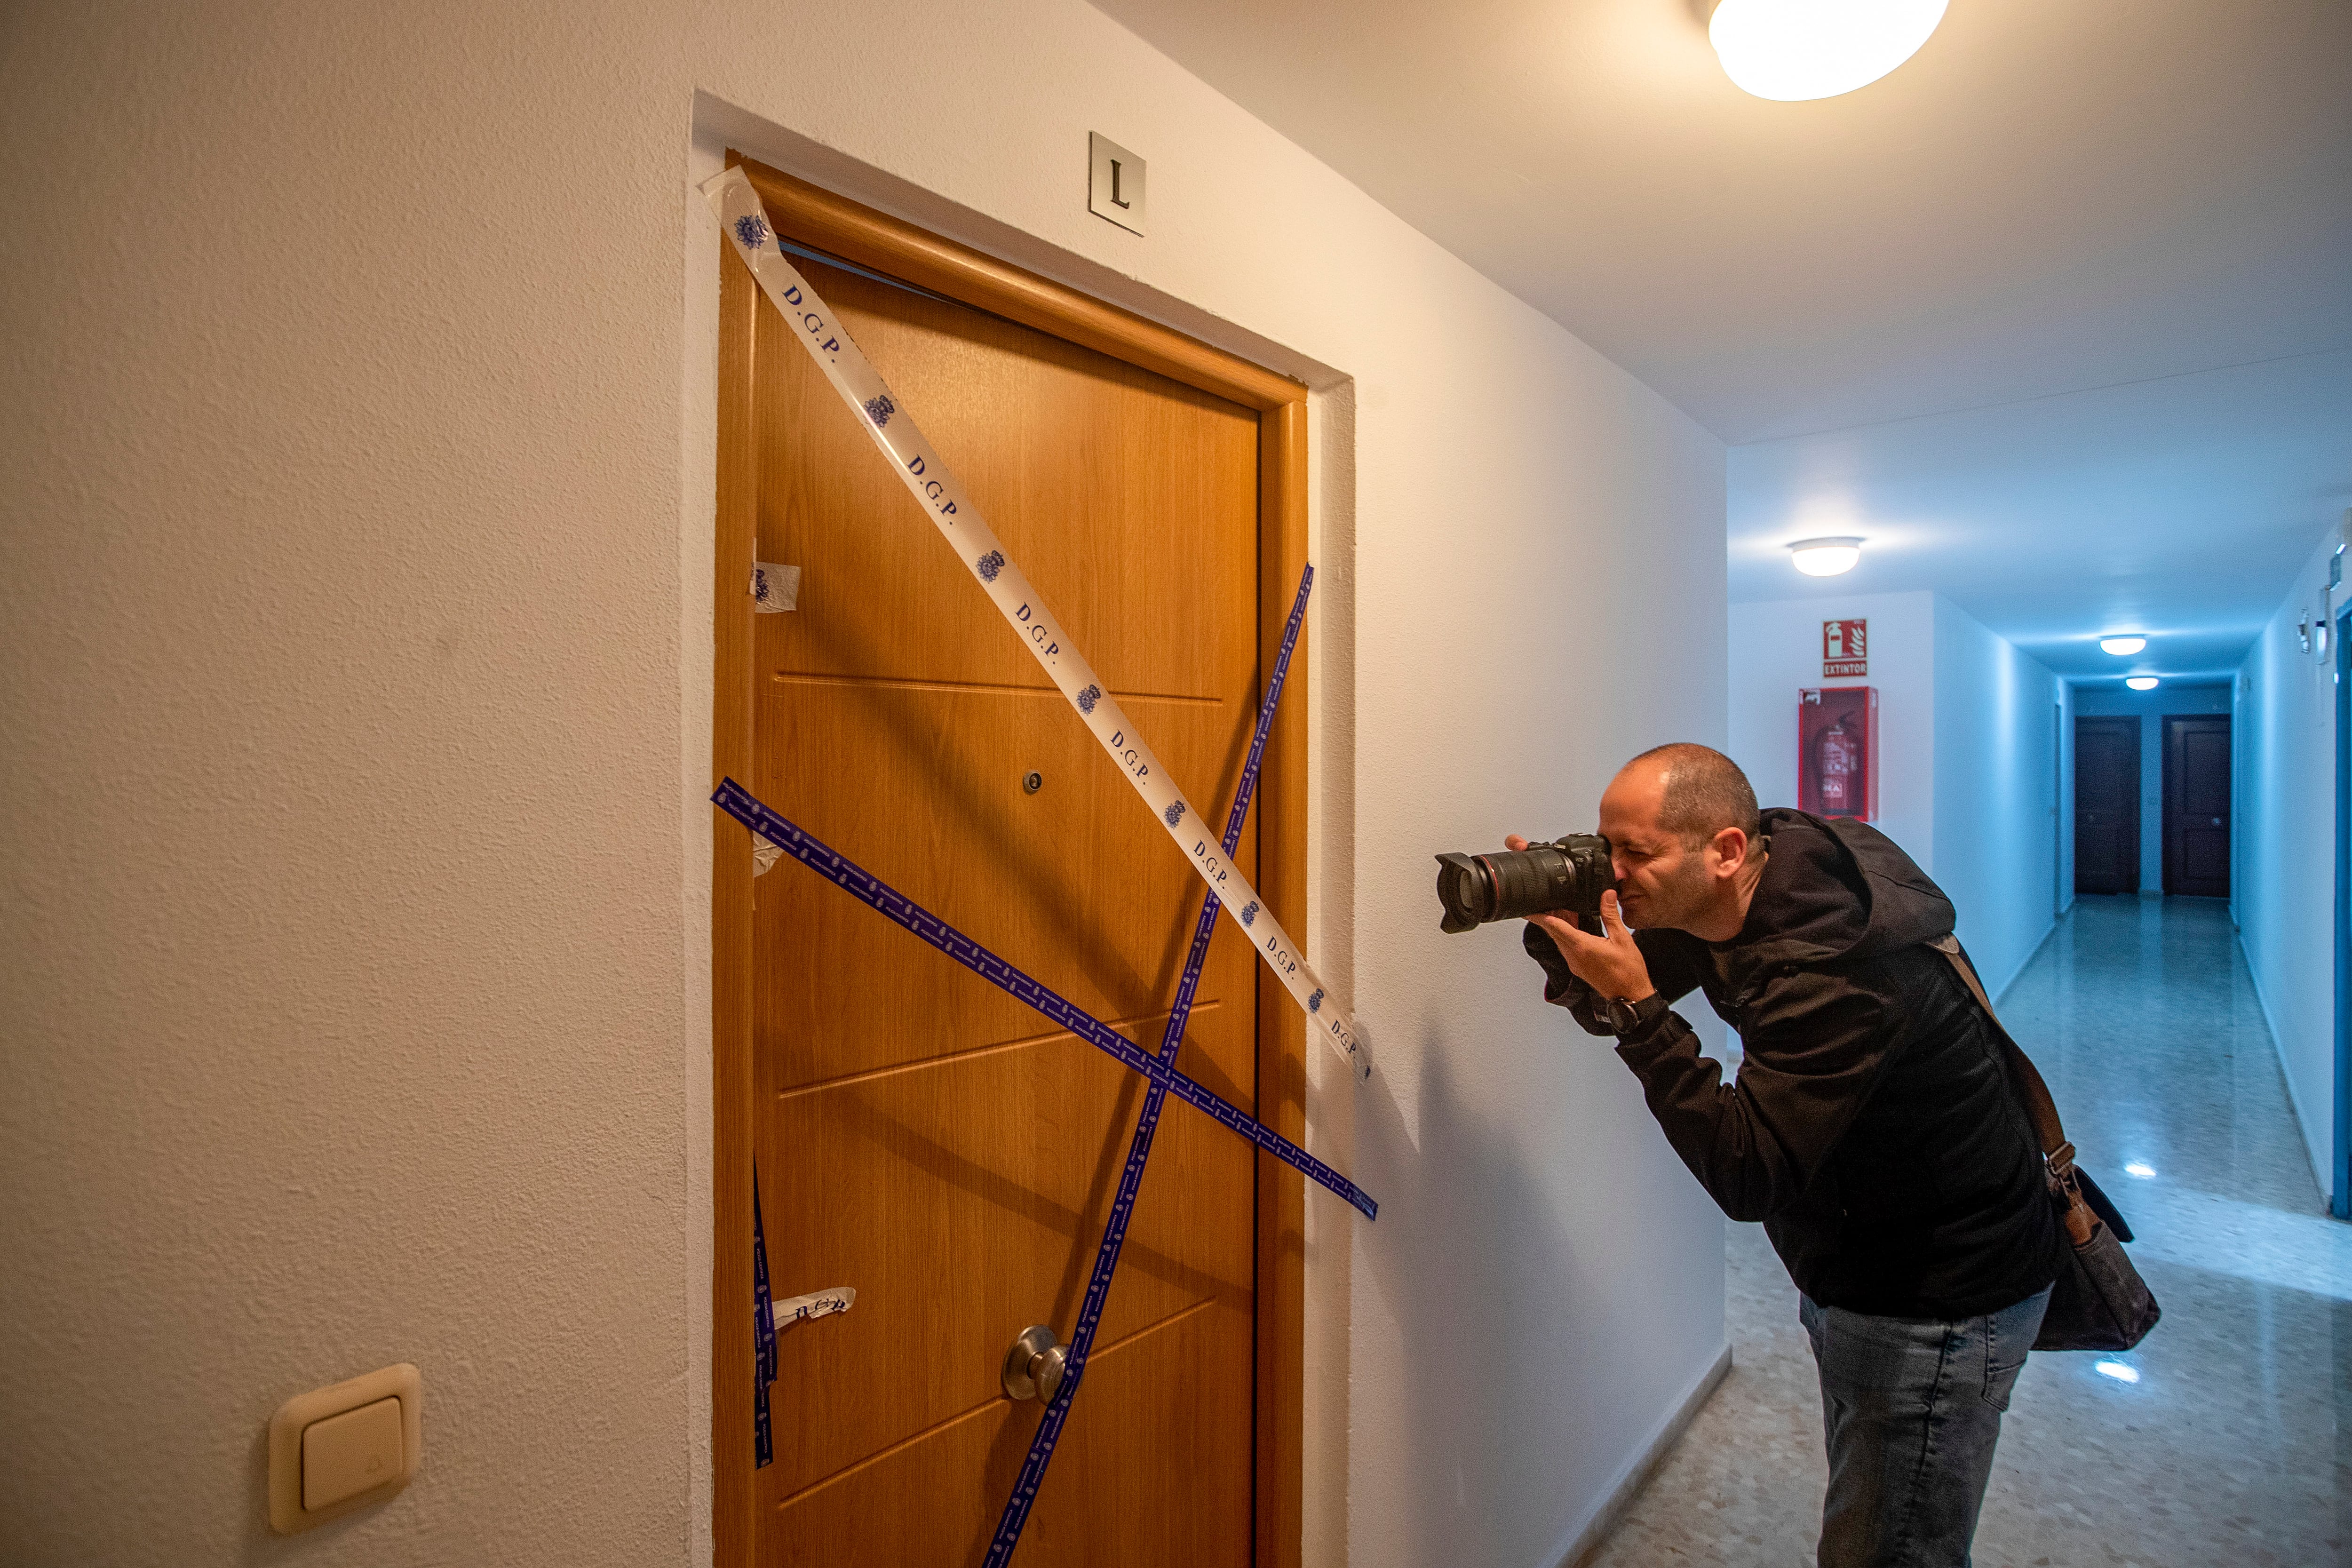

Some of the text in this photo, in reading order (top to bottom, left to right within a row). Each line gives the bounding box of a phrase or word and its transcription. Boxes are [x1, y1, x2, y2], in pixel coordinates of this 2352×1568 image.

[1111, 159, 1129, 209] L
[782, 284, 840, 363] D.G.P.
[907, 454, 957, 525] D.G.P.
[1015, 602, 1059, 665] D.G.P.
[1825, 663, 1866, 675] EXTINTOR
[1110, 730, 1149, 785] D.G.P.
[1193, 840, 1227, 890] D.G.P.
[1266, 936, 1295, 980] D.G.P.
[1331, 1019, 1356, 1059] D.G.P.
